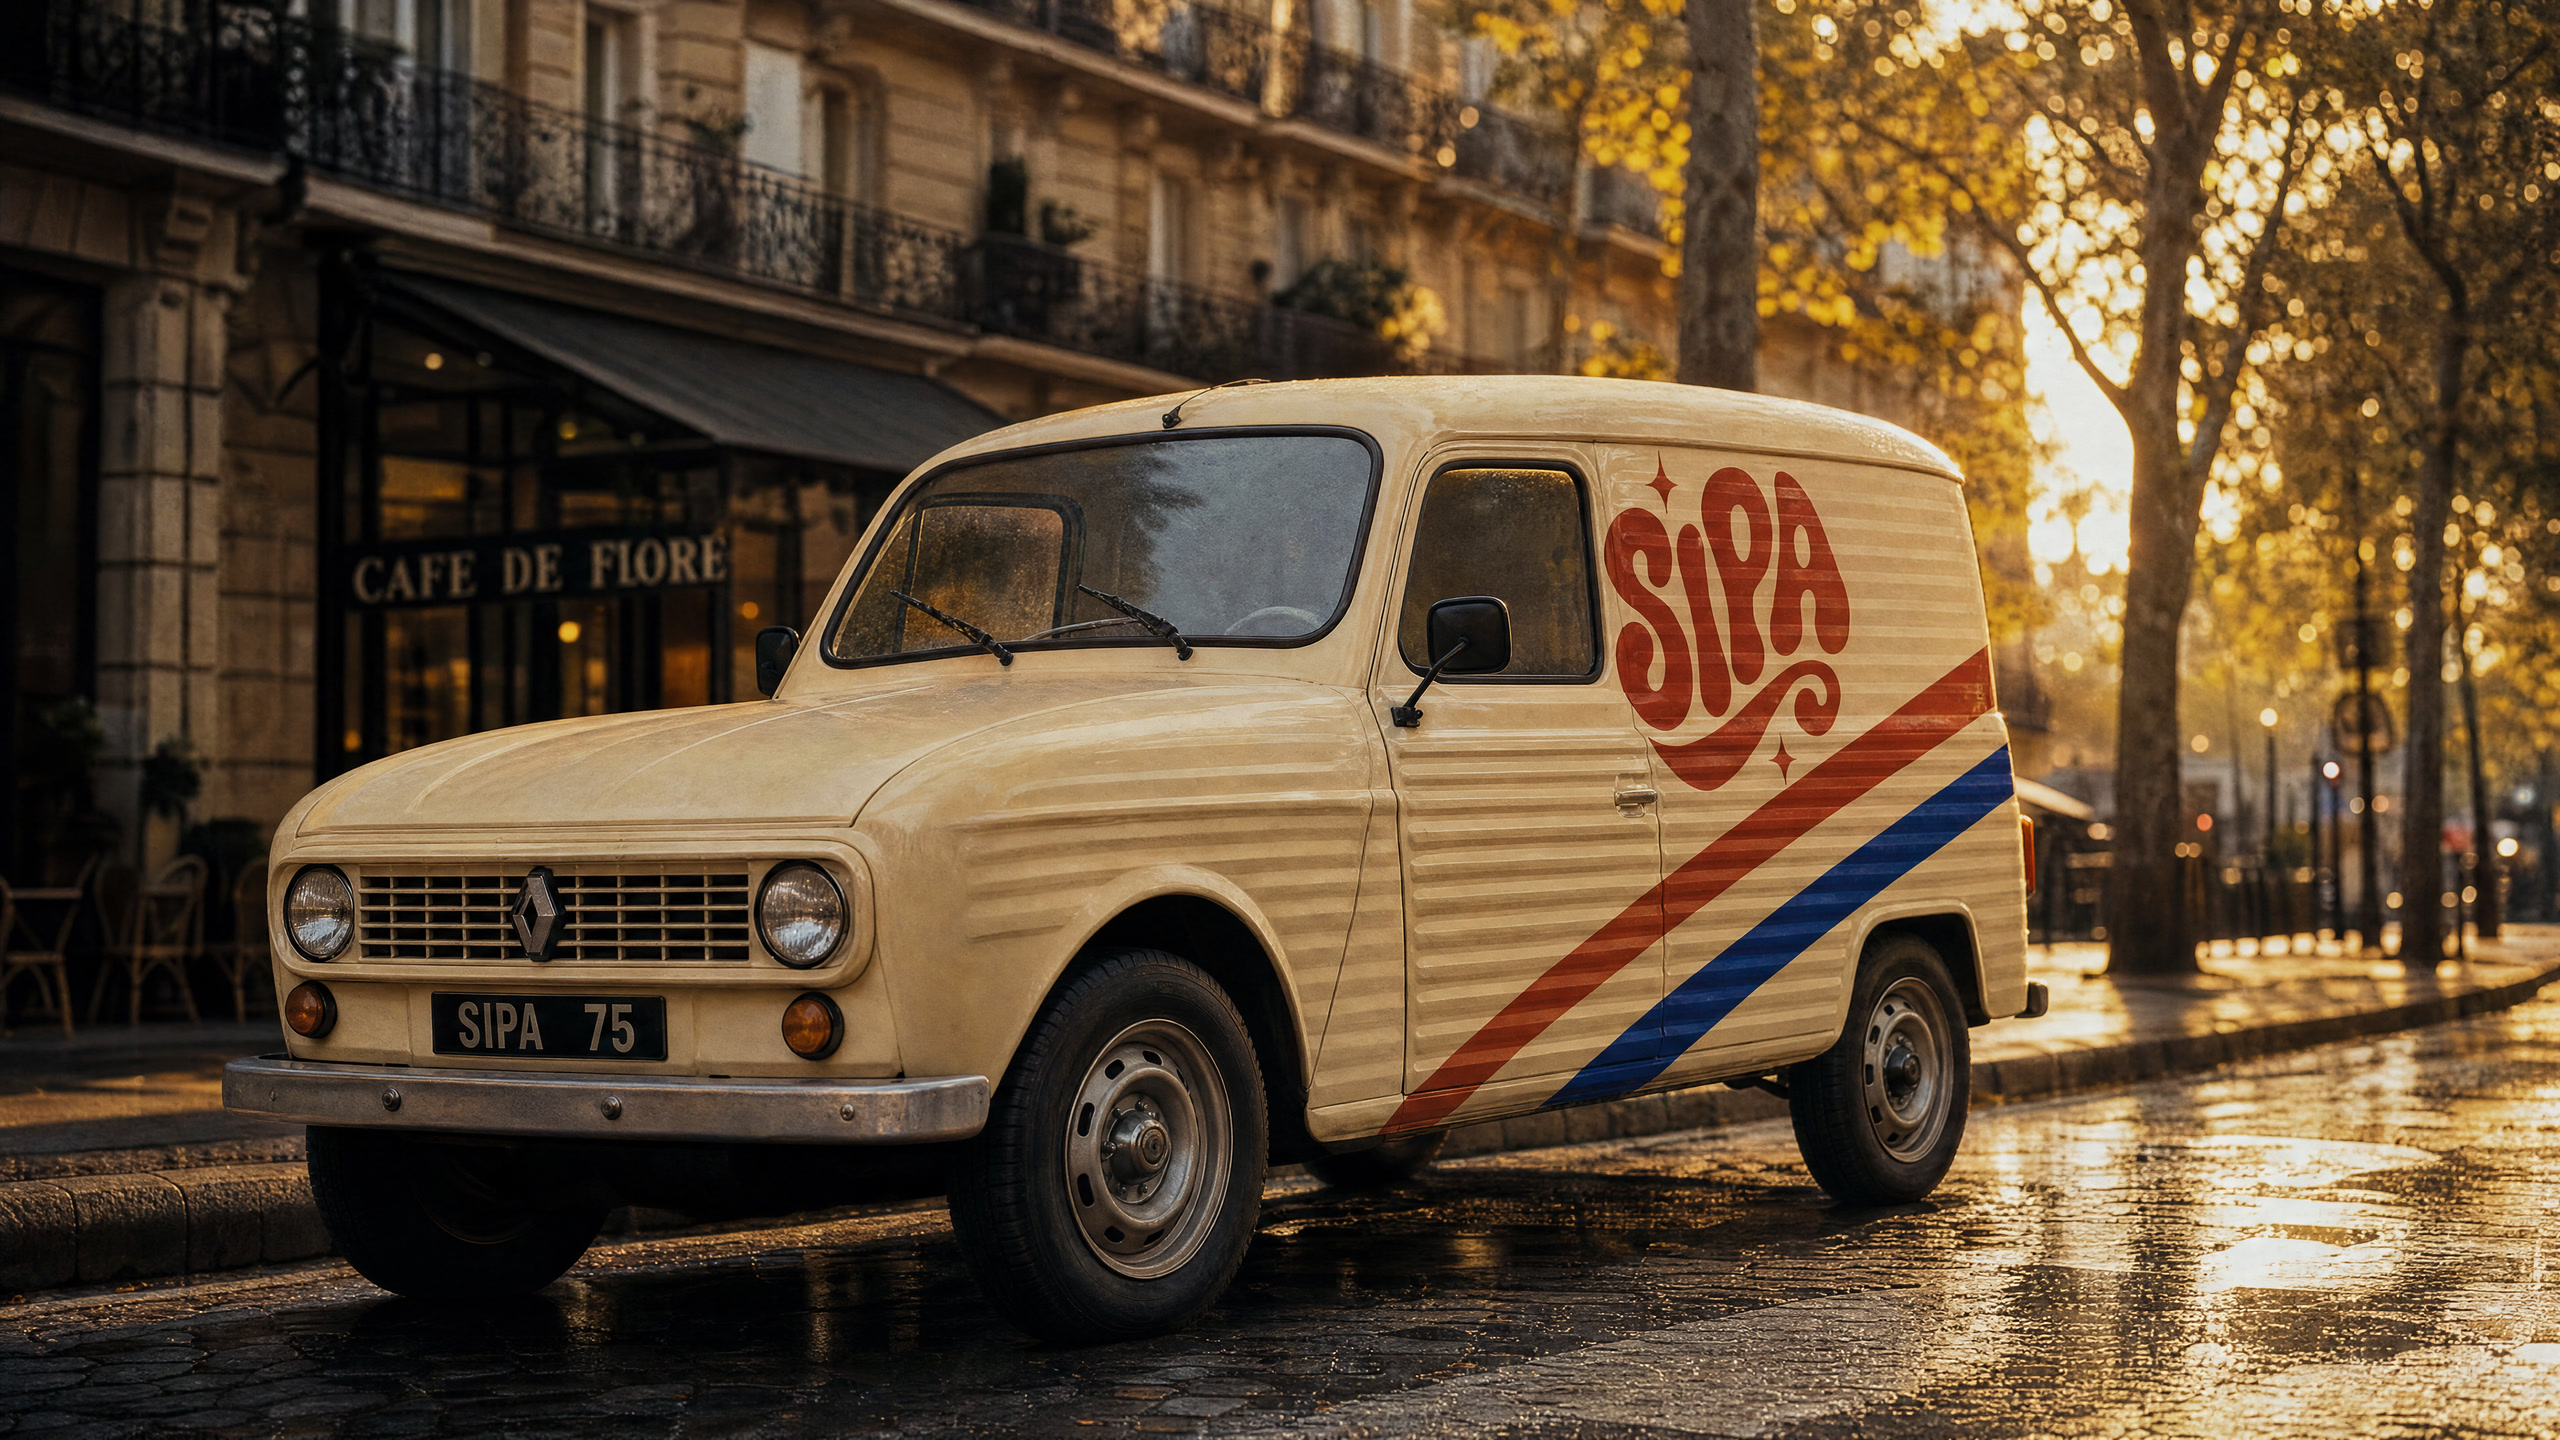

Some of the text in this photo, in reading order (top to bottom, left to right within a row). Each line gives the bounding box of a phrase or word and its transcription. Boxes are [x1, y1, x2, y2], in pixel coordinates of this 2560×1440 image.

[352, 550, 478, 604] CAFE
[502, 543, 564, 595] DE
[458, 1001, 635, 1053] SIPA 75
